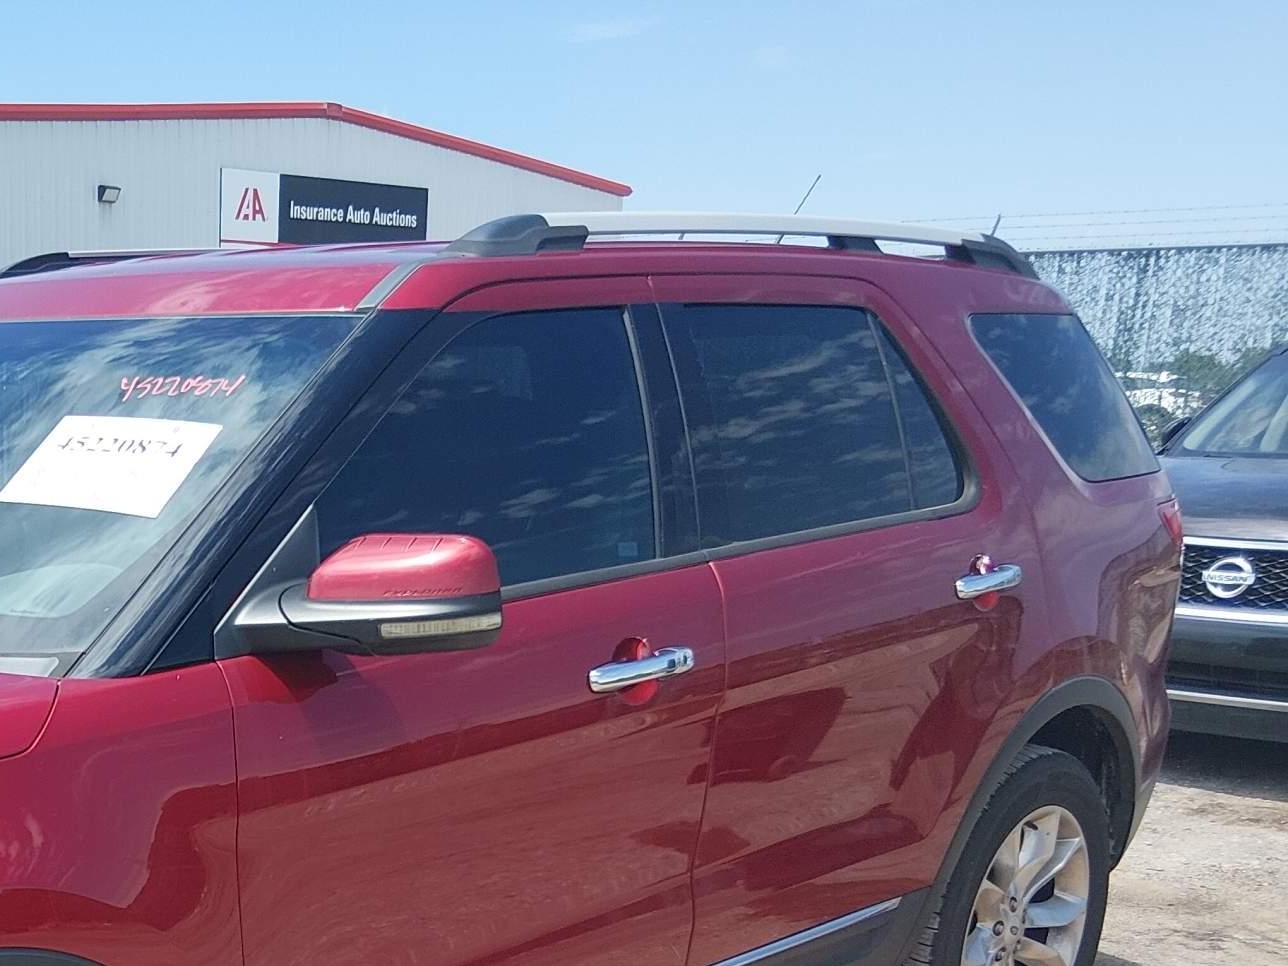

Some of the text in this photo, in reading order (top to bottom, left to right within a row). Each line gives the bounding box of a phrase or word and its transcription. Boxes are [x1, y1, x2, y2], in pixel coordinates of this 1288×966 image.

[289, 200, 417, 228] Insurance Auto Auctions
[121, 375, 246, 401] 45220874
[1206, 574, 1248, 582] NISSAN
